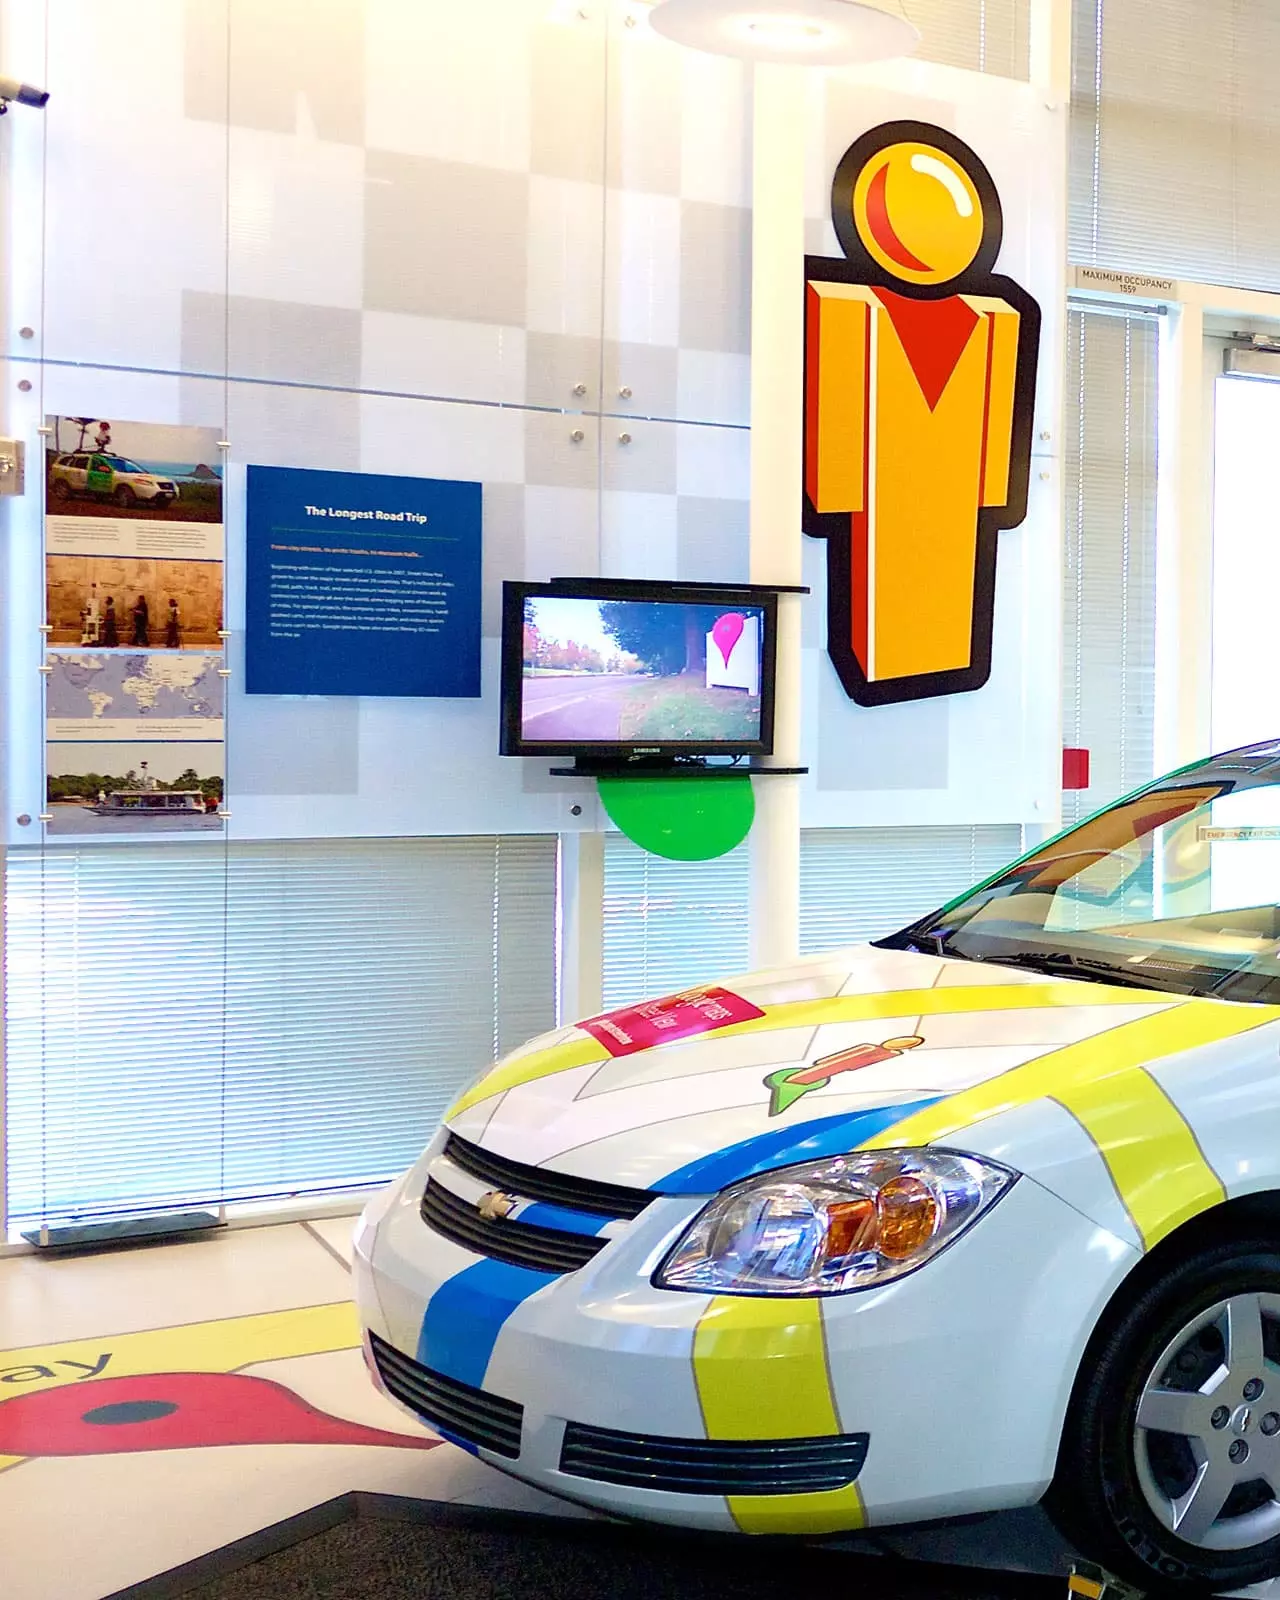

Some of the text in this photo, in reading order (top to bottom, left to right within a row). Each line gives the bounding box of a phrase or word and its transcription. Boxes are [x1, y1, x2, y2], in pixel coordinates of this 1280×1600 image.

[1082, 270, 1173, 290] MAXIMUM OCCUPANCY
[1119, 284, 1137, 294] 1559
[305, 505, 428, 525] The Longest Road Trip
